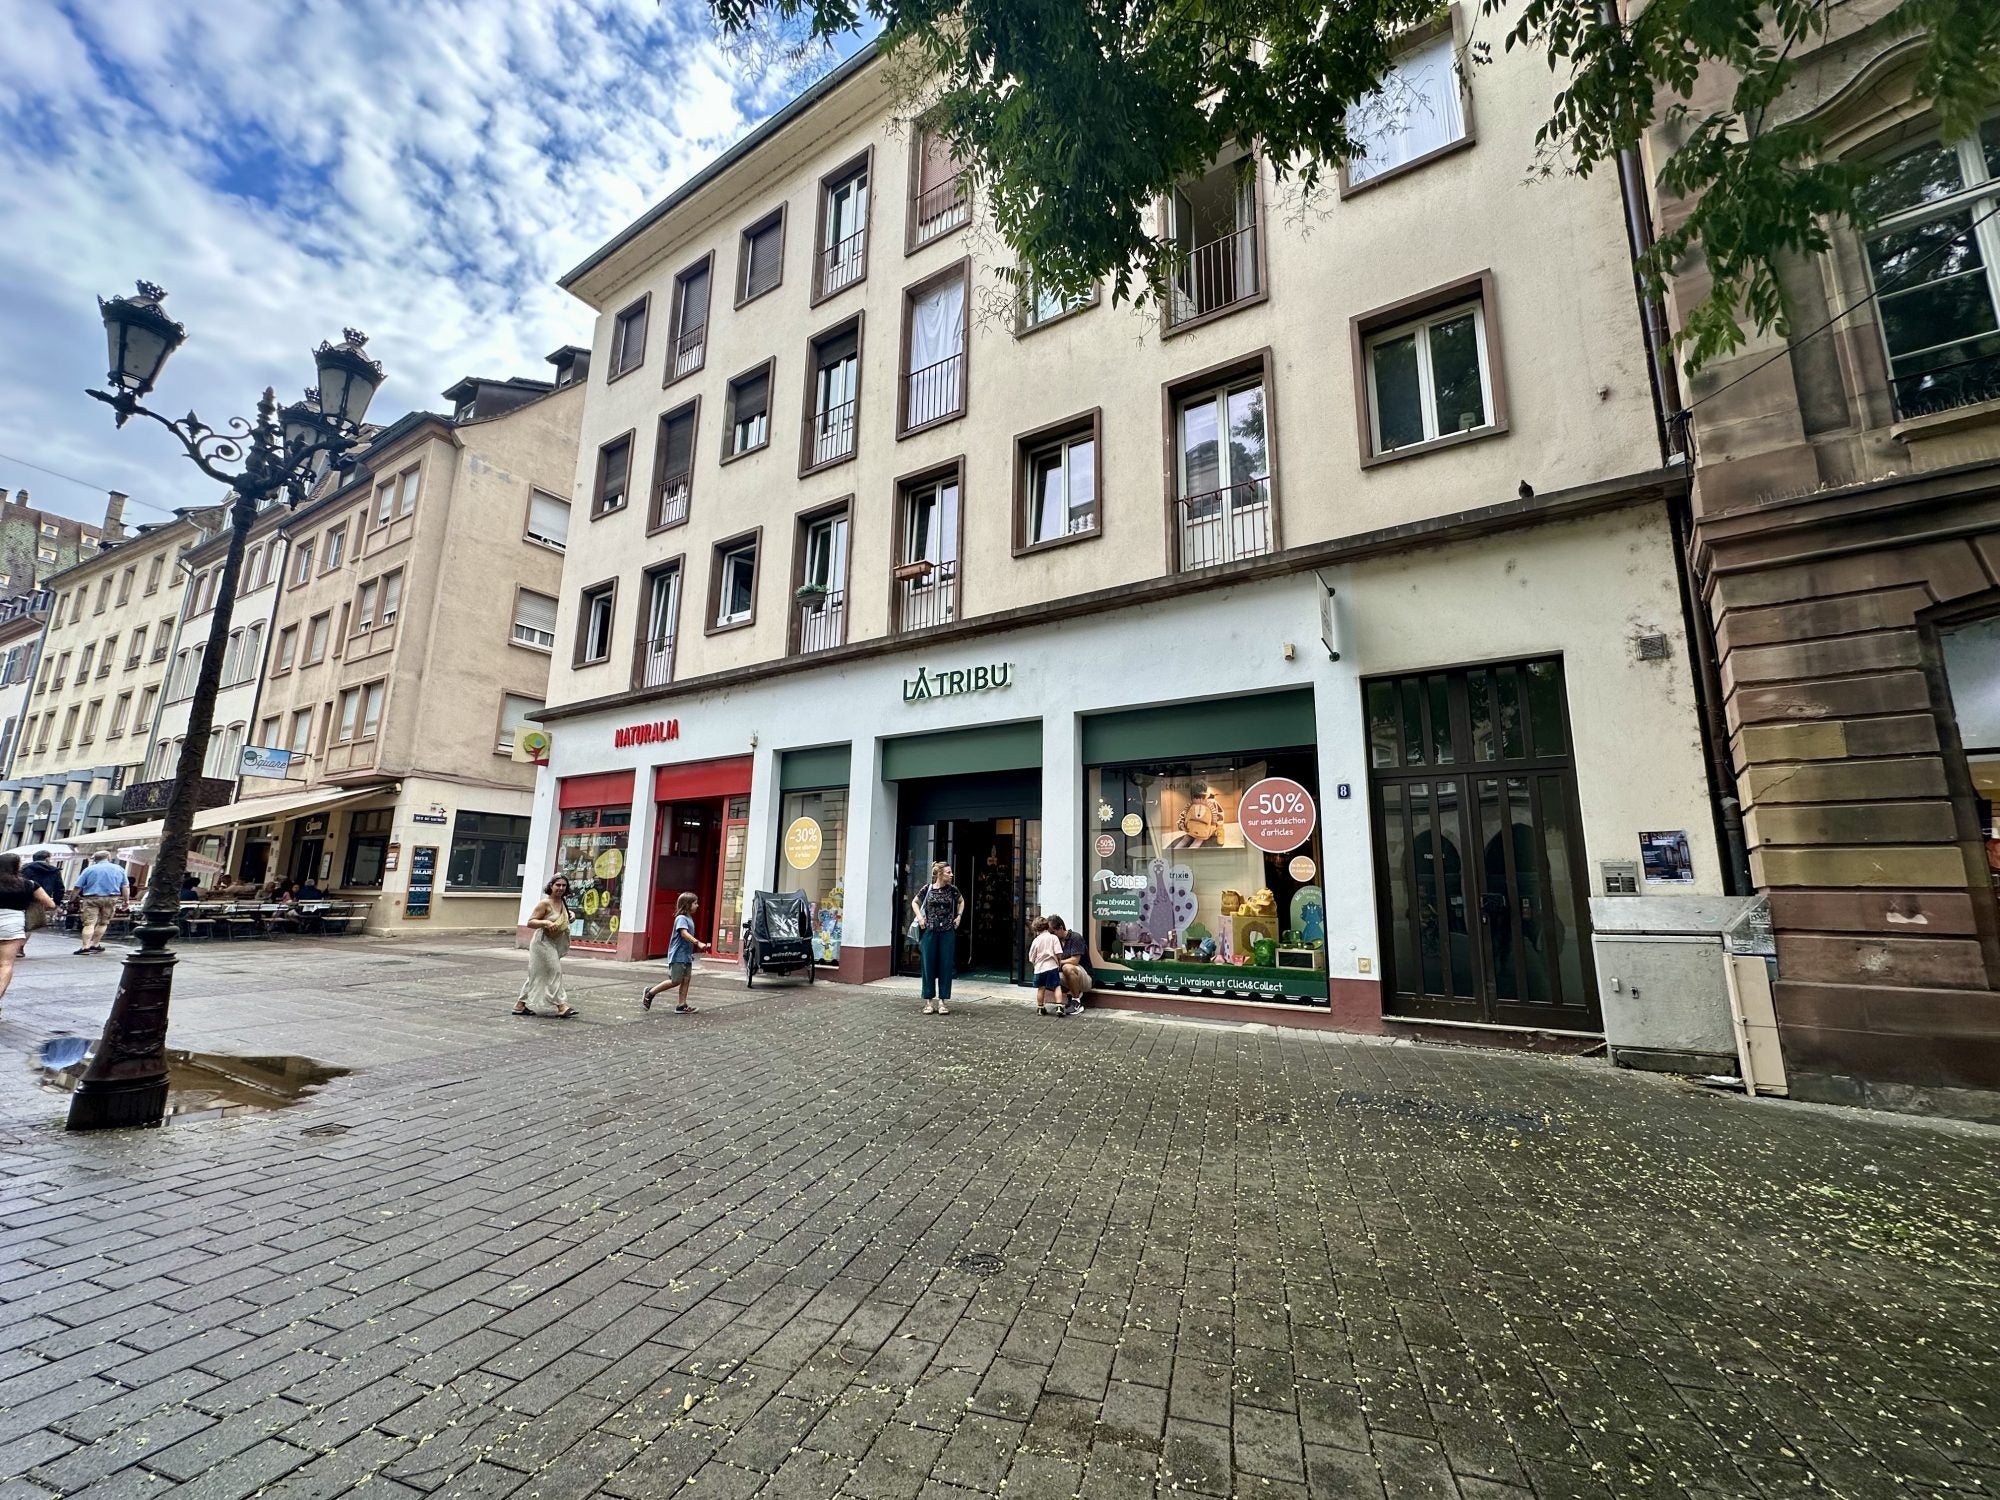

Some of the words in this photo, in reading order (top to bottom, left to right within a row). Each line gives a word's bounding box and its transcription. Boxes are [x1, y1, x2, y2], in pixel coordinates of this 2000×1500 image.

[903, 666, 932, 701] LA
[935, 661, 1009, 696] TRIBU
[614, 718, 679, 748] NATURALIA
[1340, 785, 1348, 797] 8
[1248, 792, 1305, 814] -50%
[1260, 818, 1273, 826] une
[789, 827, 818, 843] -30%
[1260, 827, 1295, 837] d'articles
[1110, 875, 1147, 889] SOLDES
[1169, 870, 1190, 880] trixie
[1122, 973, 1173, 985] www.latribu.fr
[1180, 976, 1215, 987] Livraison
[1216, 978, 1226, 988] et
[1227, 978, 1284, 992] Click&Collect
